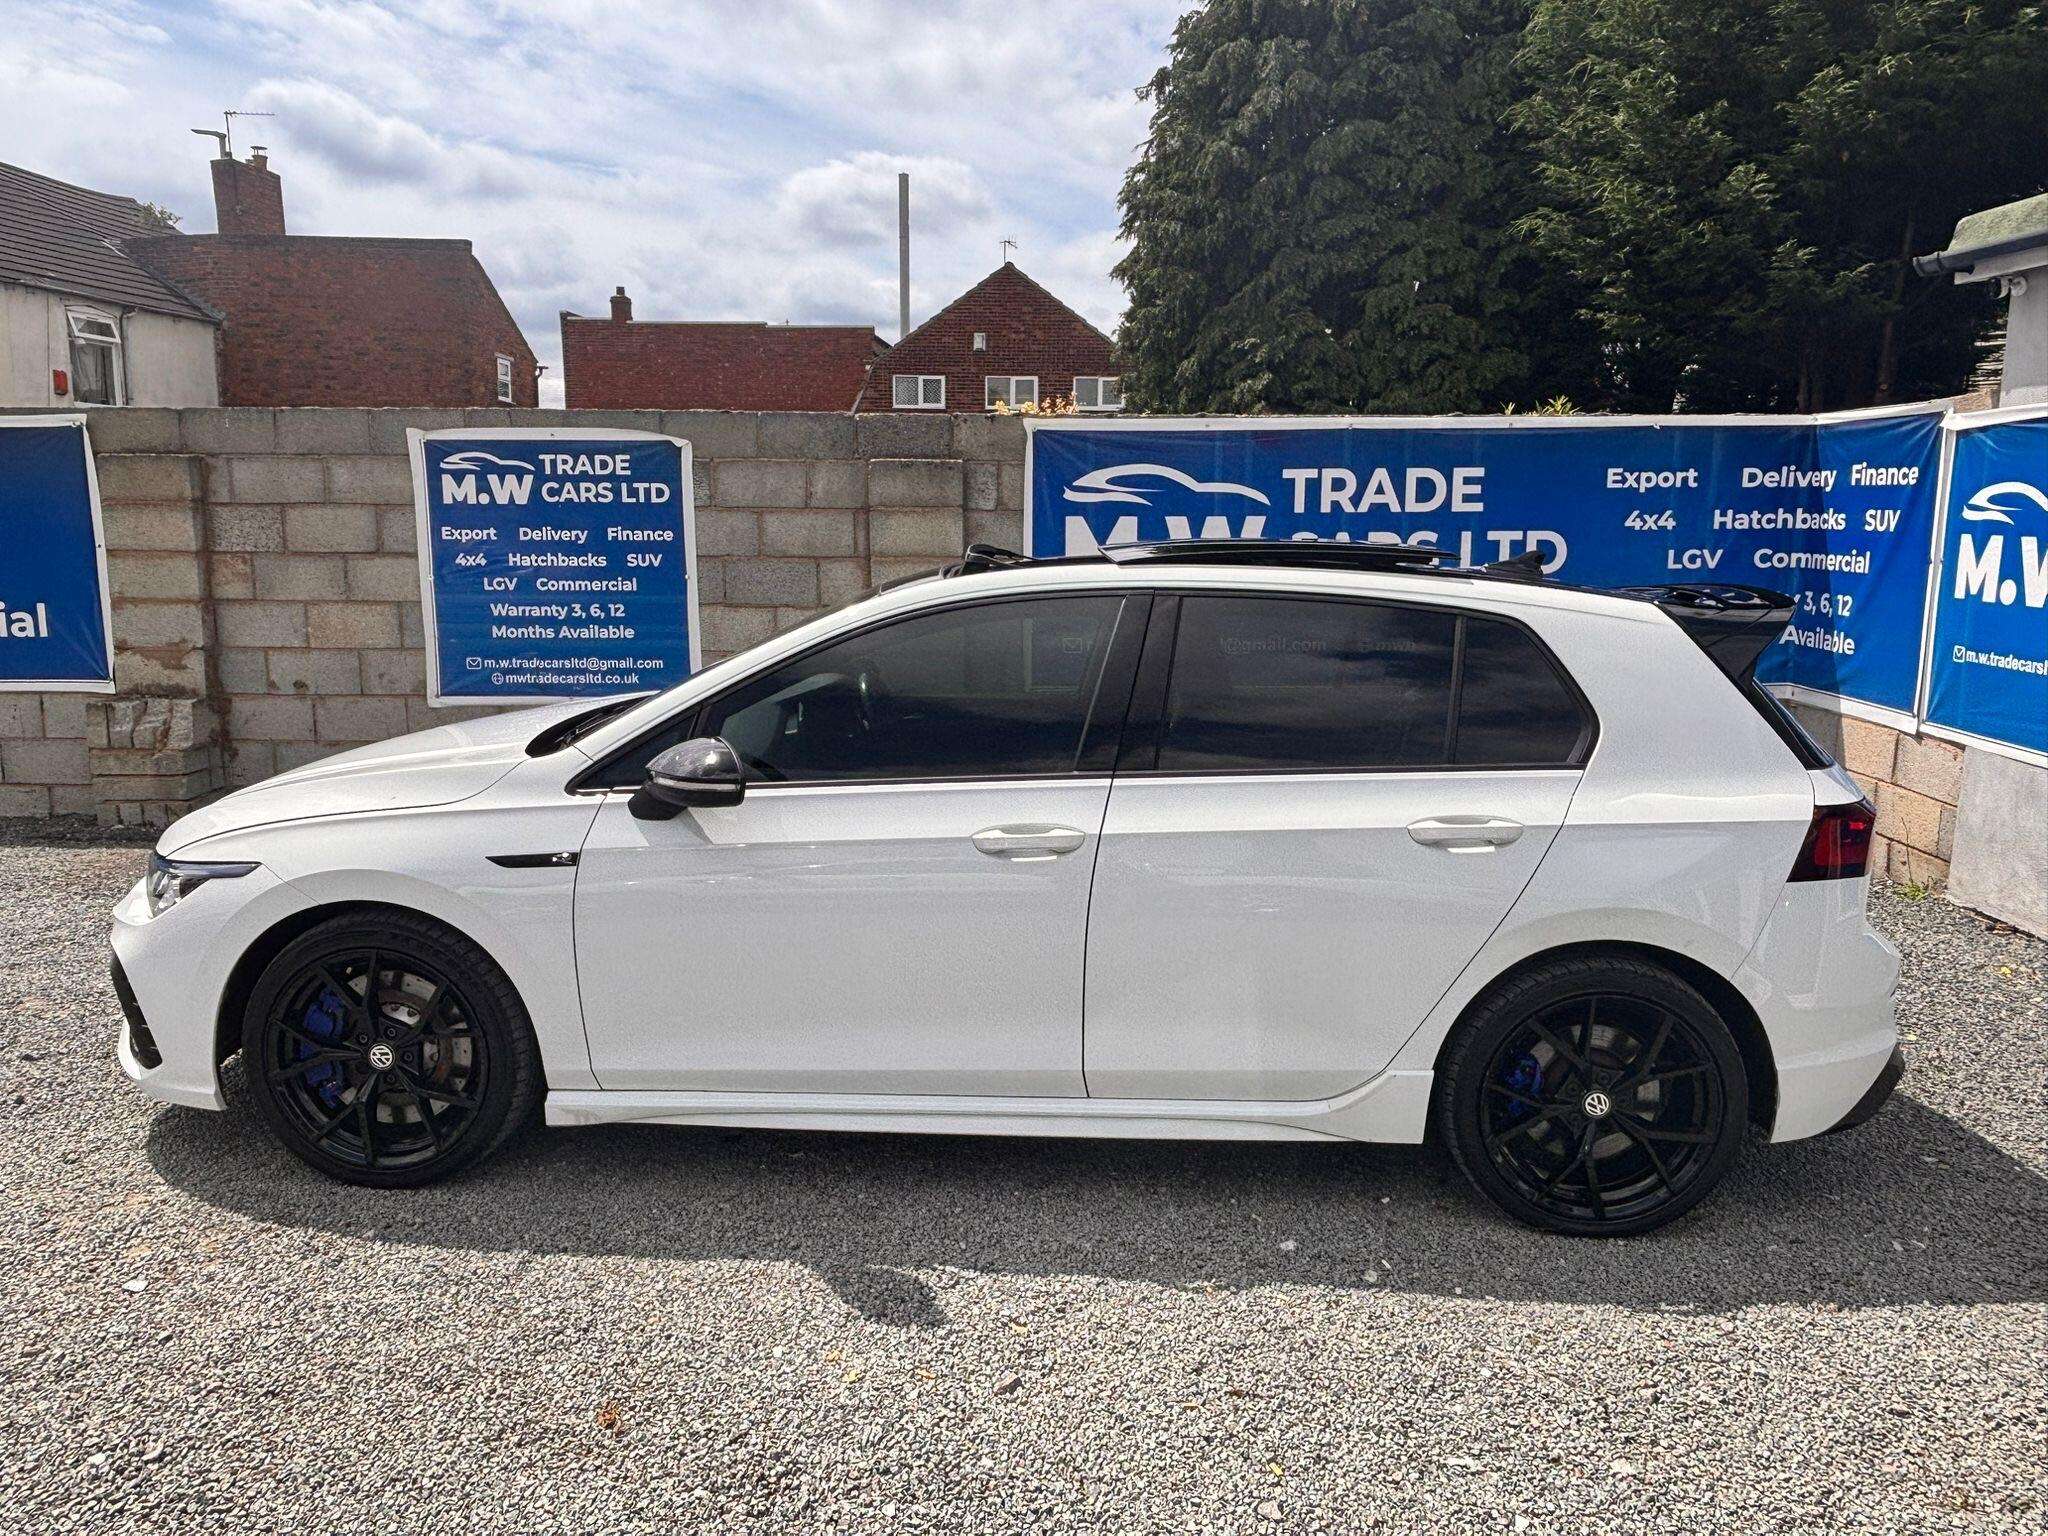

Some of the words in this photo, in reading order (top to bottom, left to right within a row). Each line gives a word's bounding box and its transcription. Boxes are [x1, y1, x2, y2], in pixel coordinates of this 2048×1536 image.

[539, 454, 631, 475] TRADE
[1607, 468, 1698, 492] Export
[1742, 465, 1837, 492] Delivery
[1852, 462, 1918, 485] Finance
[442, 474, 533, 504] M.W
[542, 482, 613, 502] CARS
[621, 483, 670, 503] LTD
[1283, 467, 1485, 513] TRADE
[1625, 510, 1676, 530] 4x4
[1714, 508, 1846, 530] Hatchbacks
[1865, 509, 1900, 532] SUV
[442, 527, 497, 542] Export
[520, 527, 588, 544] Delivery
[608, 527, 673, 541] Finance
[455, 553, 487, 566] 4x4
[509, 553, 606, 566] Hatchbacks
[627, 554, 662, 567] SUV
[1668, 549, 1723, 569] LGV
[1754, 549, 1870, 573] Commercial
[484, 577, 517, 590] LGV
[536, 577, 637, 591] Commercial
[490, 603, 567, 619] Warranty
[572, 604, 586, 618] 3,
[590, 604, 604, 619] 6,
[608, 604, 625, 616] 12
[1804, 591, 1816, 615] 3,
[1821, 593, 1832, 617] 6,
[1837, 595, 1852, 616] 12
[492, 625, 555, 638] Months
[559, 625, 634, 638] Available
[1779, 625, 1855, 654] Available
[484, 658, 663, 671] m.w.tradecarsltd@gmail.com
[506, 673, 639, 683] mwtradecarsltd.co.uk
